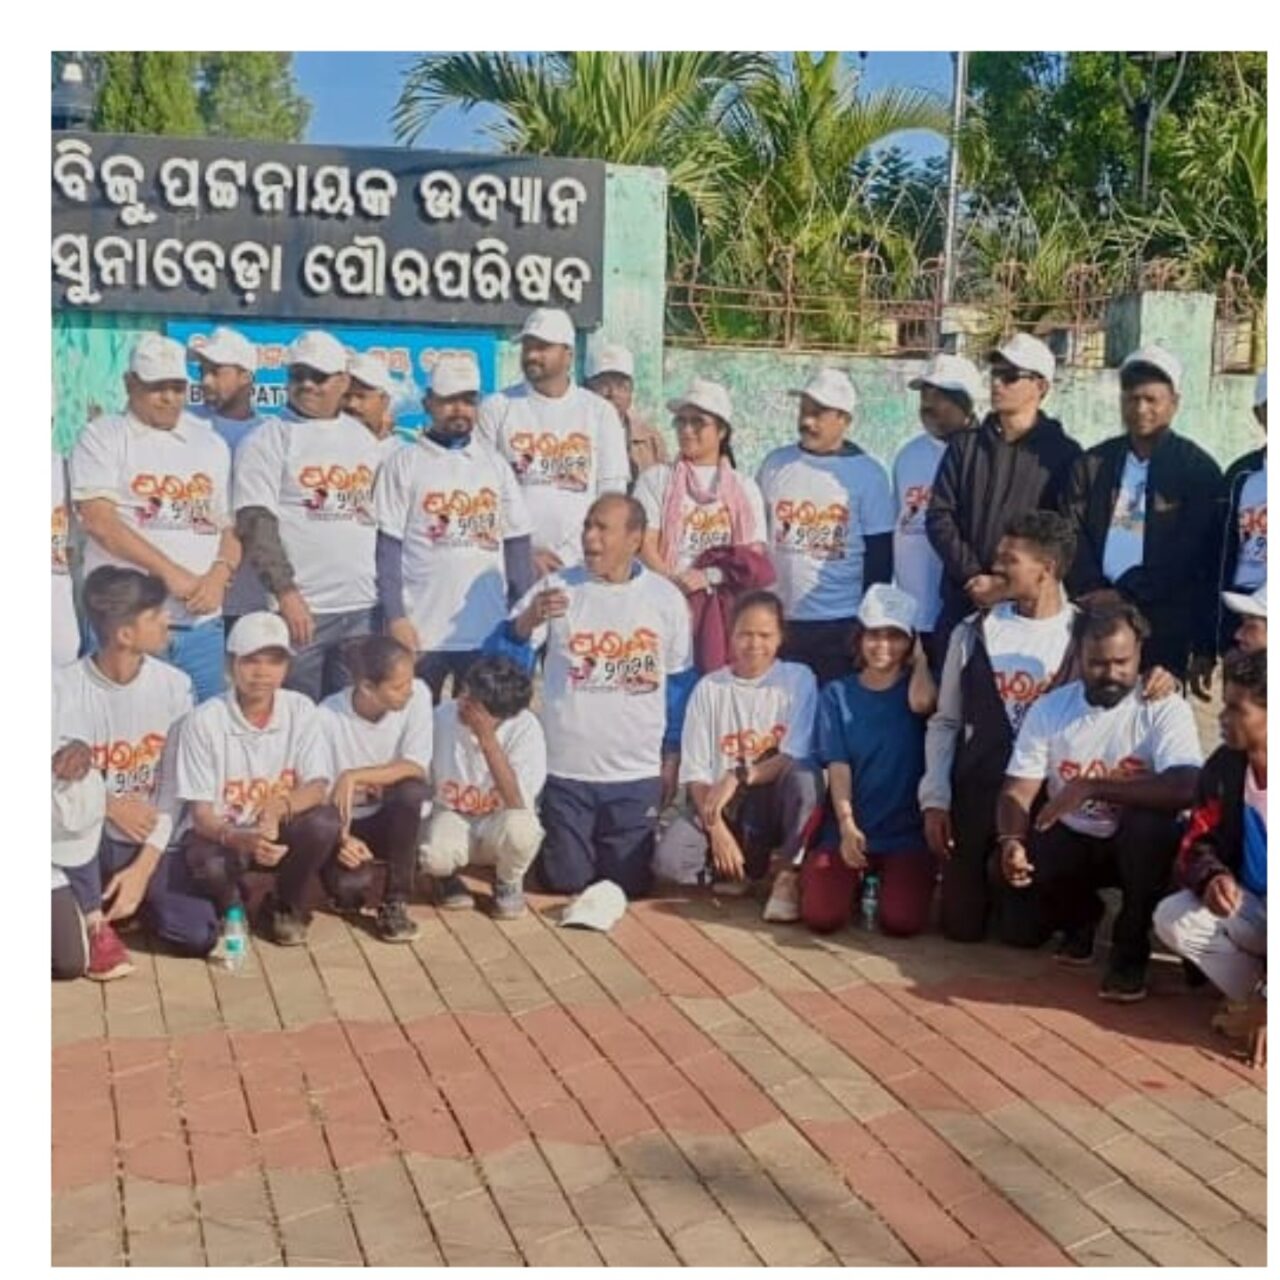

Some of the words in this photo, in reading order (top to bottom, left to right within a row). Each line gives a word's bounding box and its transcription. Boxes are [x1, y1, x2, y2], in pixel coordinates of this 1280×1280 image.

[53, 138, 157, 226] ବିଜୁ
[160, 157, 398, 218] ପଟ୍ଟନାୟକ
[419, 170, 586, 227] ଉଦ୍ୟାନ
[52, 231, 283, 305] ସୁନାବେଡ଼ା
[303, 235, 592, 304] ପୌରପରିଷଦ
